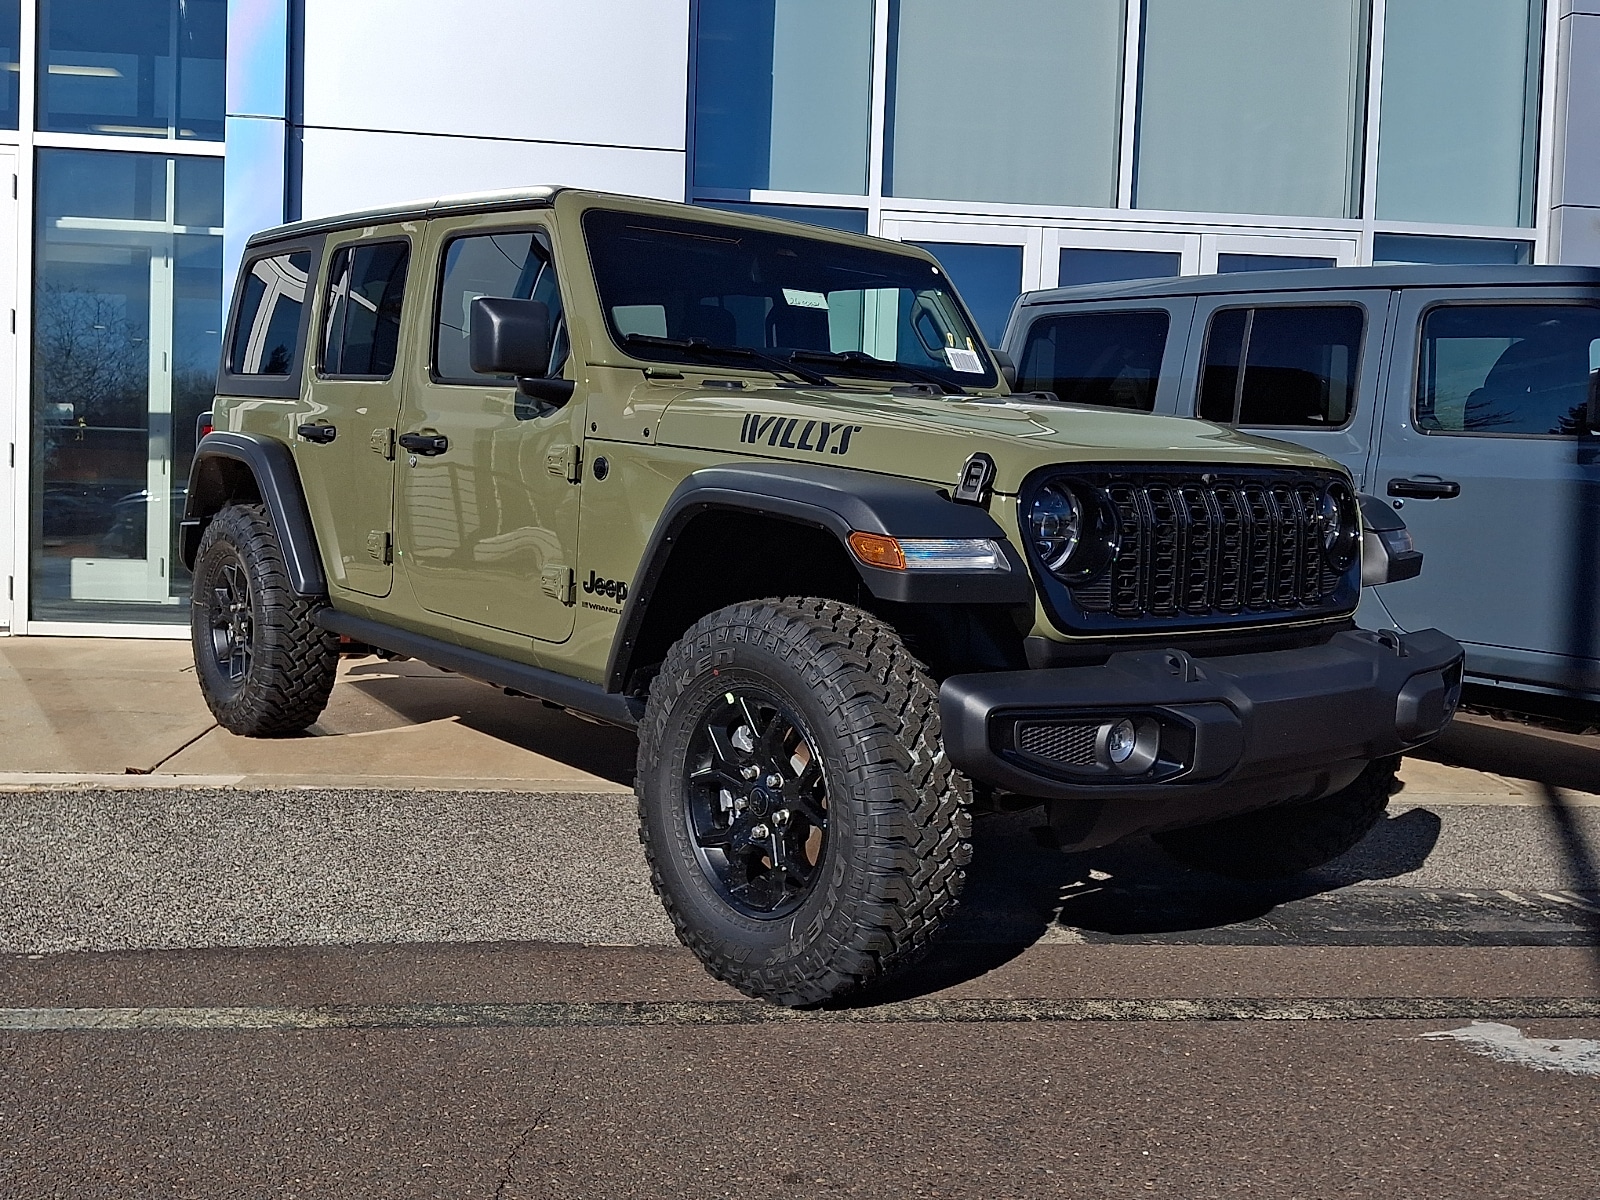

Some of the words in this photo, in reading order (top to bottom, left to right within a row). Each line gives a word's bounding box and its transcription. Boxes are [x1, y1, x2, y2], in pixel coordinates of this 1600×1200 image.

[740, 413, 862, 455] WILLYS
[583, 570, 628, 604] Jeep
[589, 602, 623, 615] WRANGL
